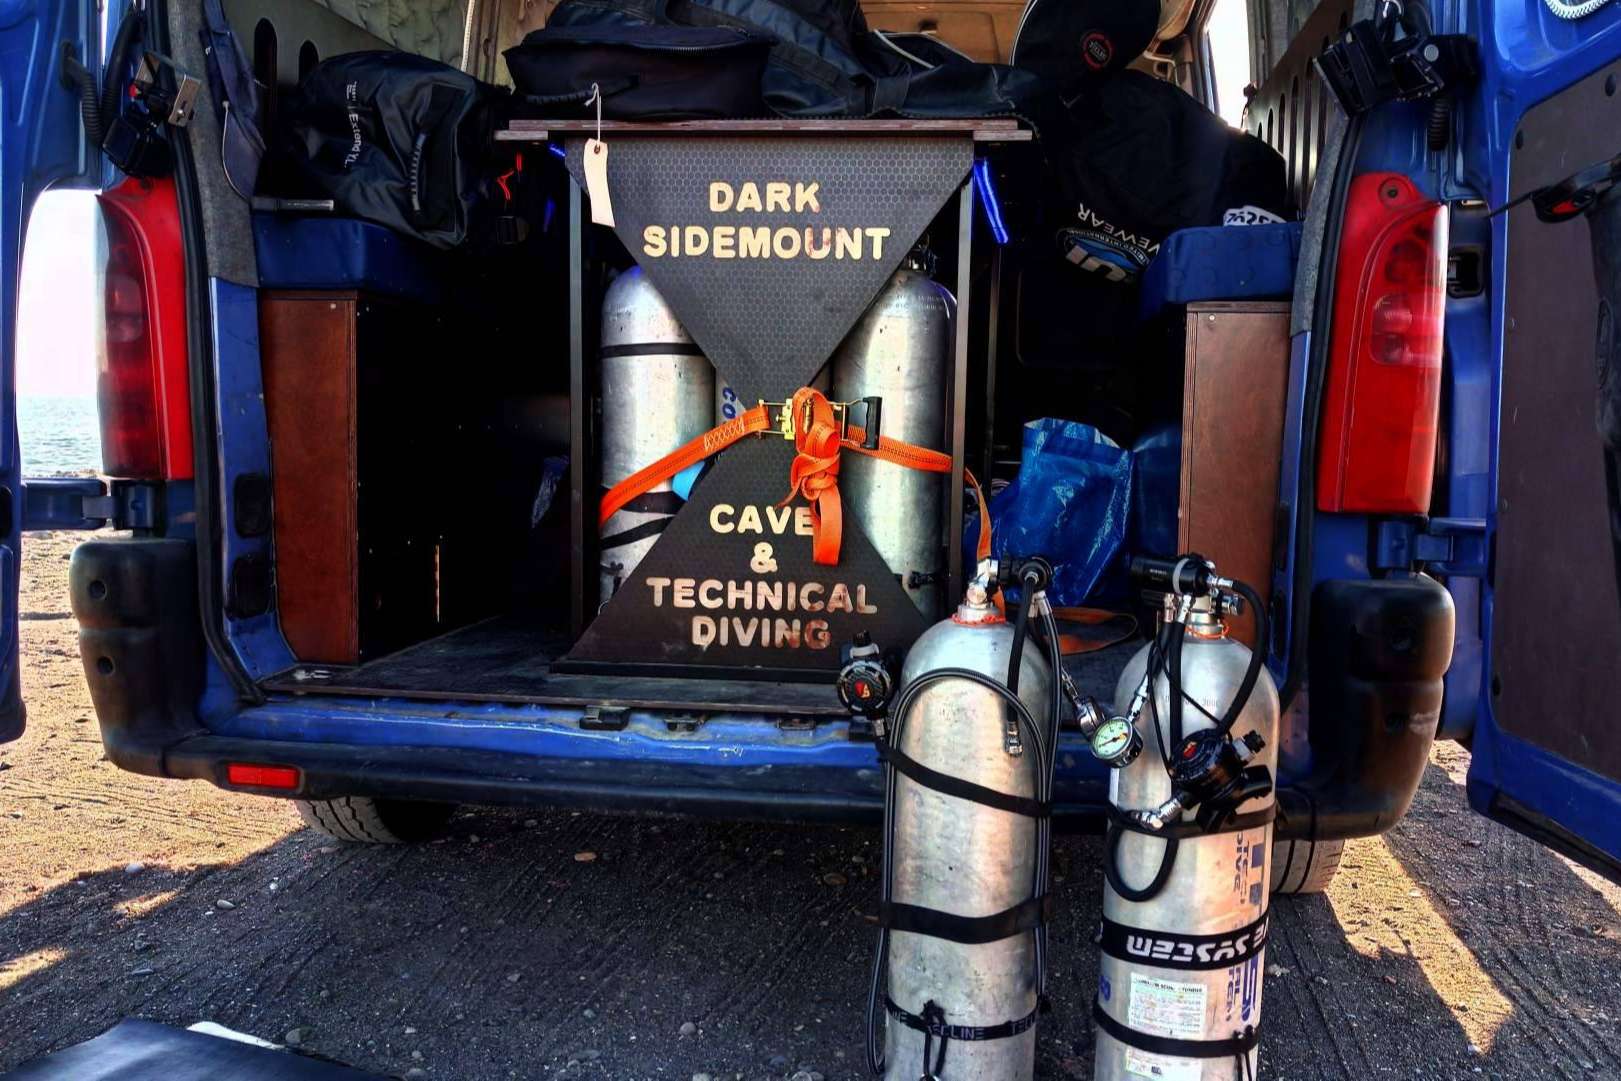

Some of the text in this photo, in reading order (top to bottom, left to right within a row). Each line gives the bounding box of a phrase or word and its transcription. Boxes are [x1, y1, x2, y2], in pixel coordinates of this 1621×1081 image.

[709, 182, 820, 213] DARK
[643, 225, 891, 260] SIDEMOUNT
[709, 504, 815, 536] CAVE
[750, 542, 778, 574] &
[646, 577, 878, 614] TECHNICAL
[692, 615, 831, 649] DIVING
